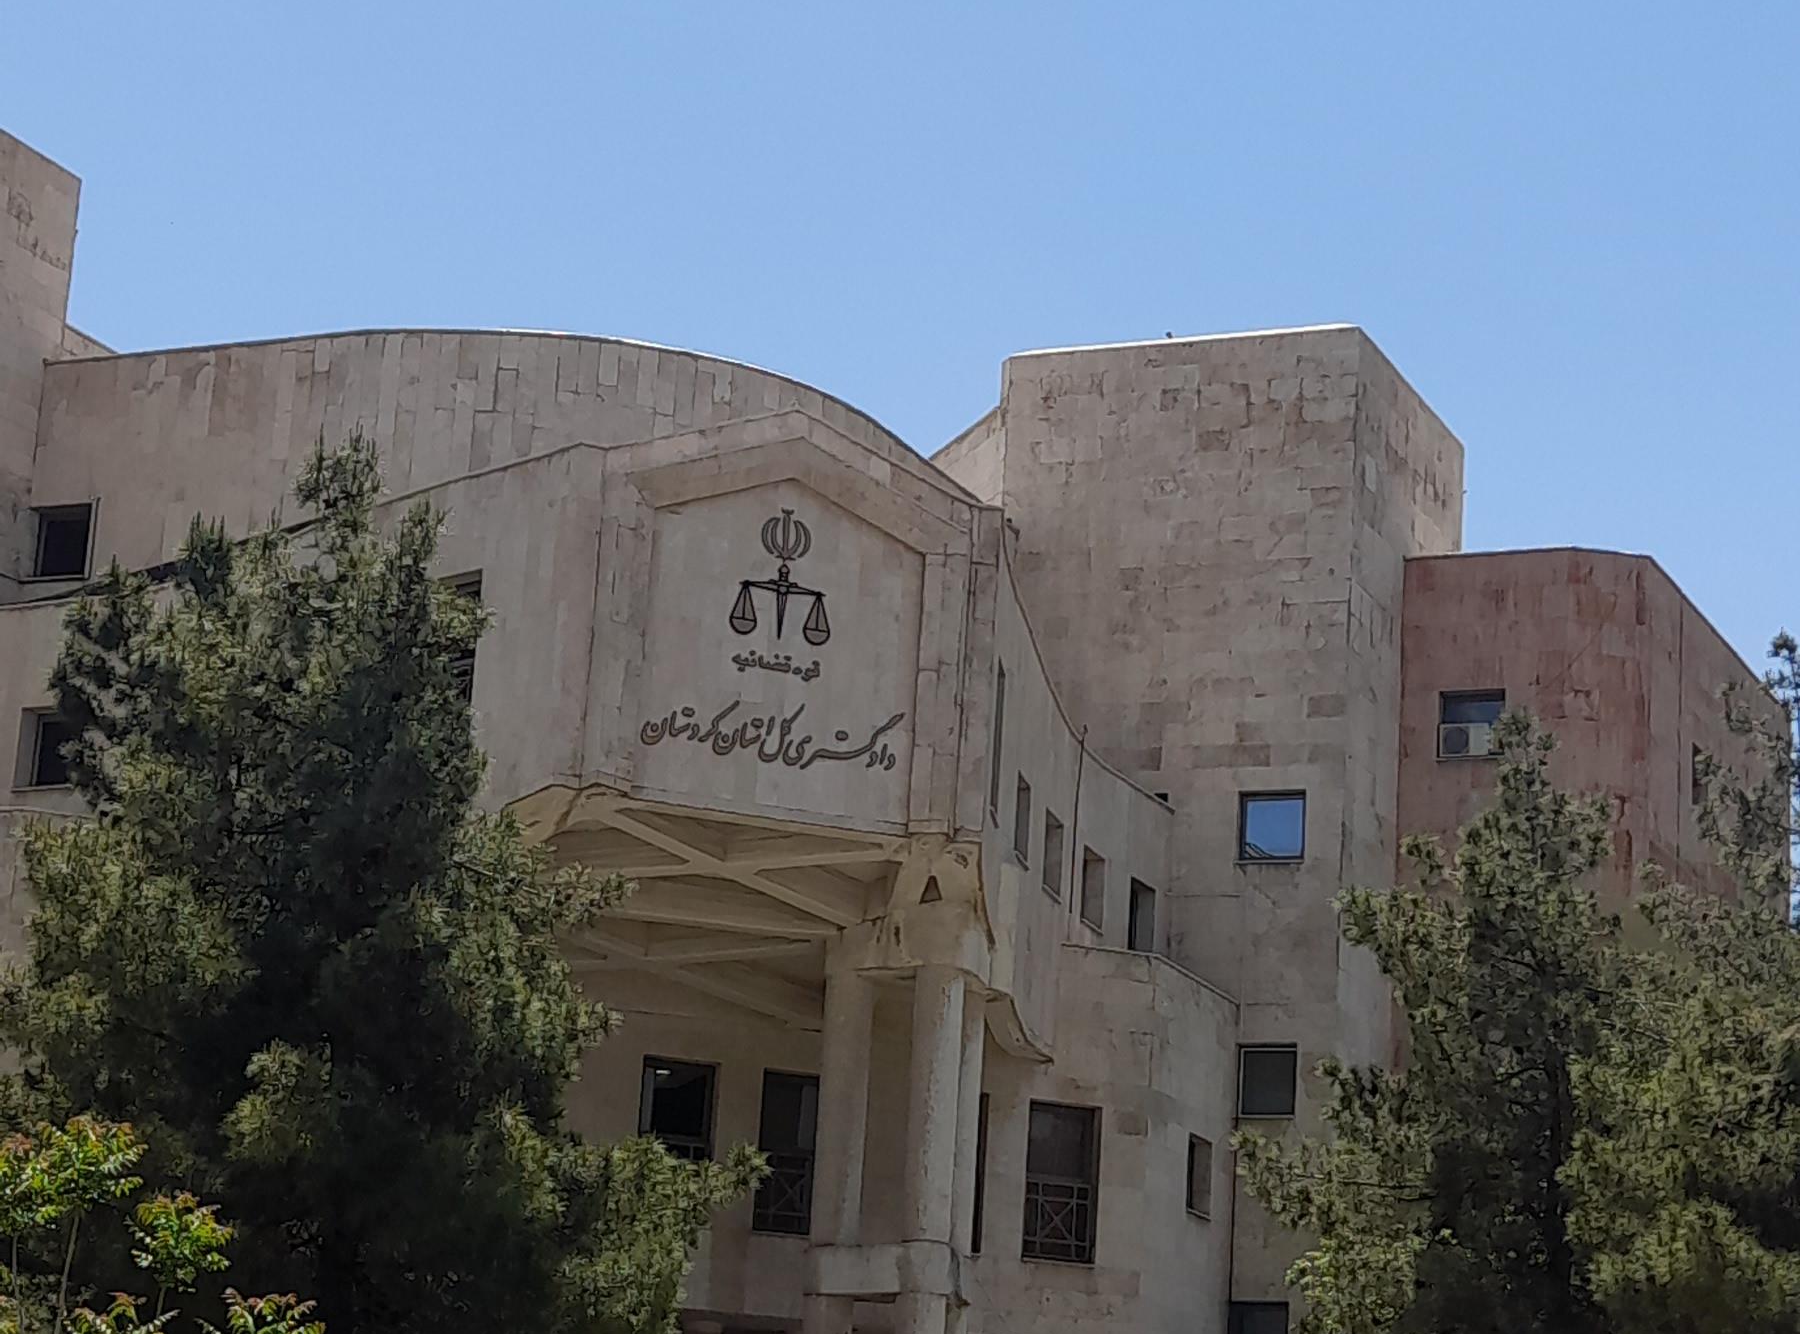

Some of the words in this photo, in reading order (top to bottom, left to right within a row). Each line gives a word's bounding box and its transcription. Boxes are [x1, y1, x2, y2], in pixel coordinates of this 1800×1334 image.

[791, 659, 821, 683] قوه
[639, 699, 741, 746] کردستان
[711, 715, 777, 756] استان
[757, 702, 806, 764] کل
[782, 711, 906, 771] دادگستری
